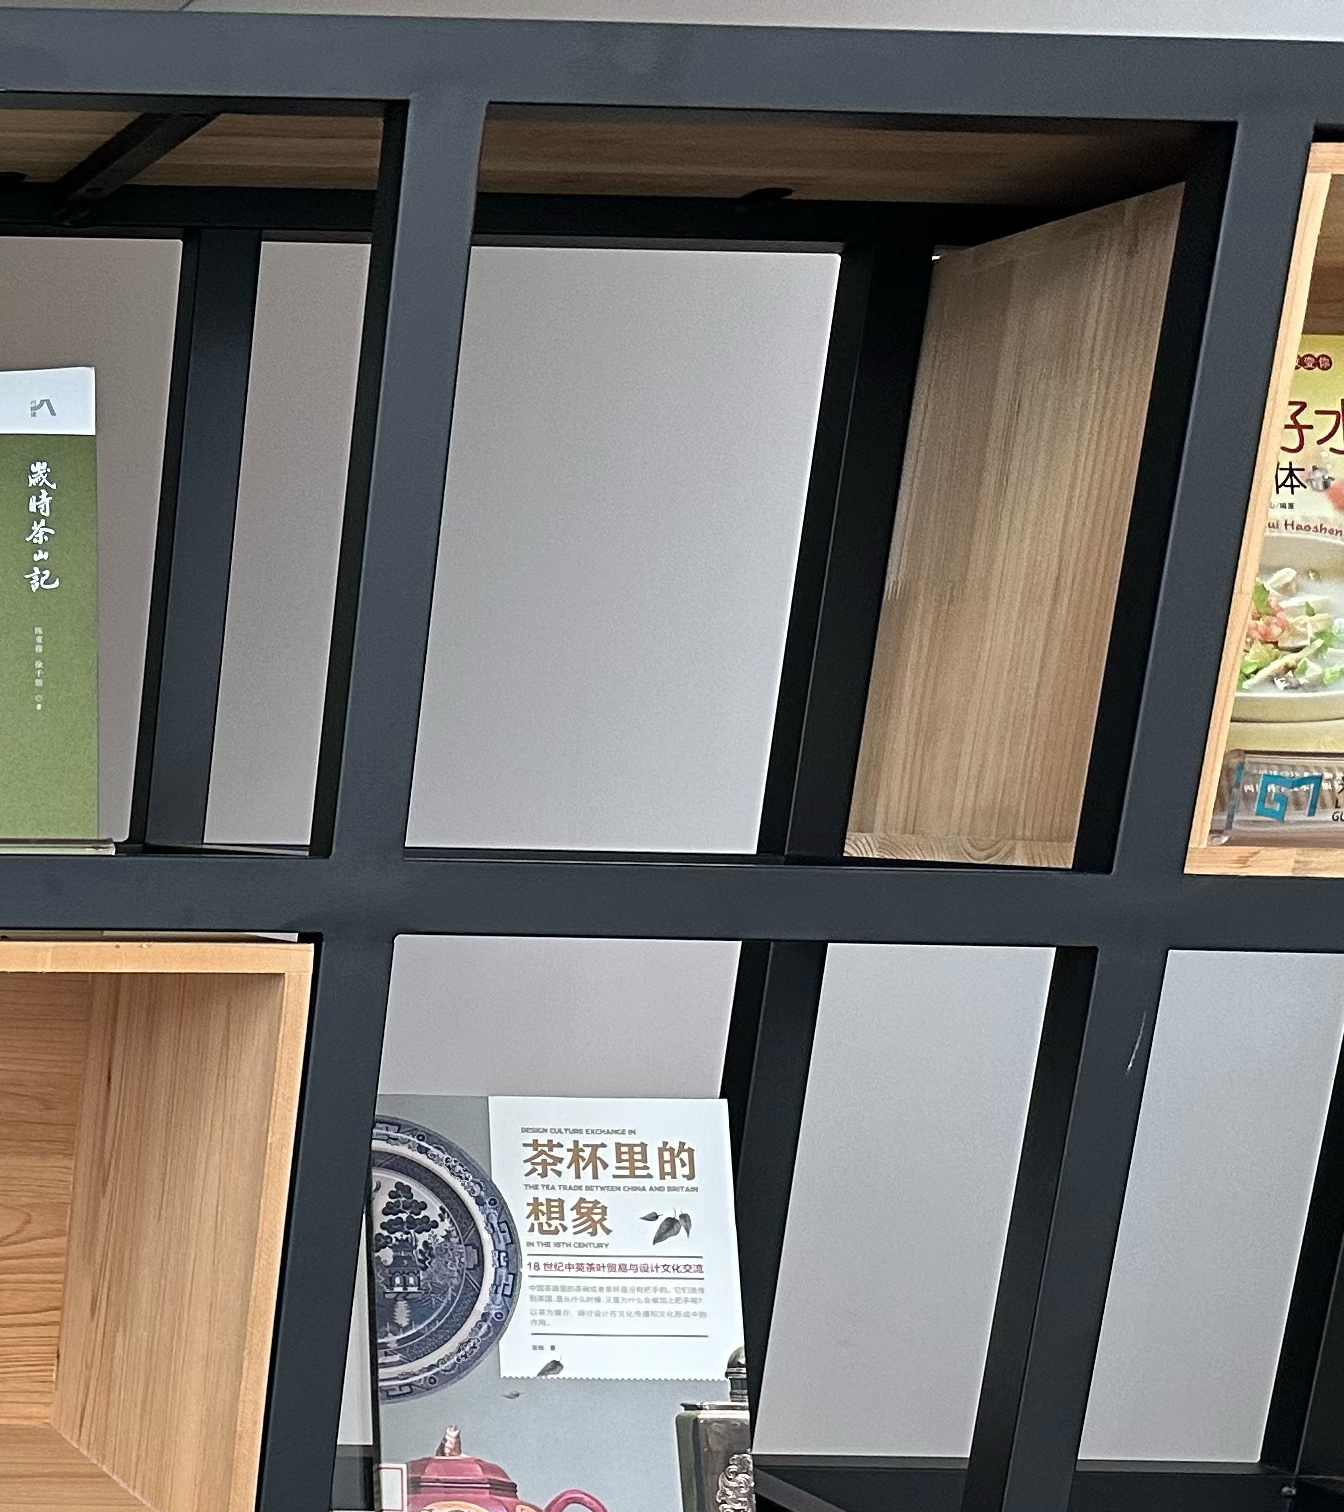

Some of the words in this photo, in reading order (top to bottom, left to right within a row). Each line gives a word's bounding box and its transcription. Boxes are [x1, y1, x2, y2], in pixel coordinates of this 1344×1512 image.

[522, 1138, 696, 1181] 茶杯里的
[526, 1196, 613, 1237] 想象
